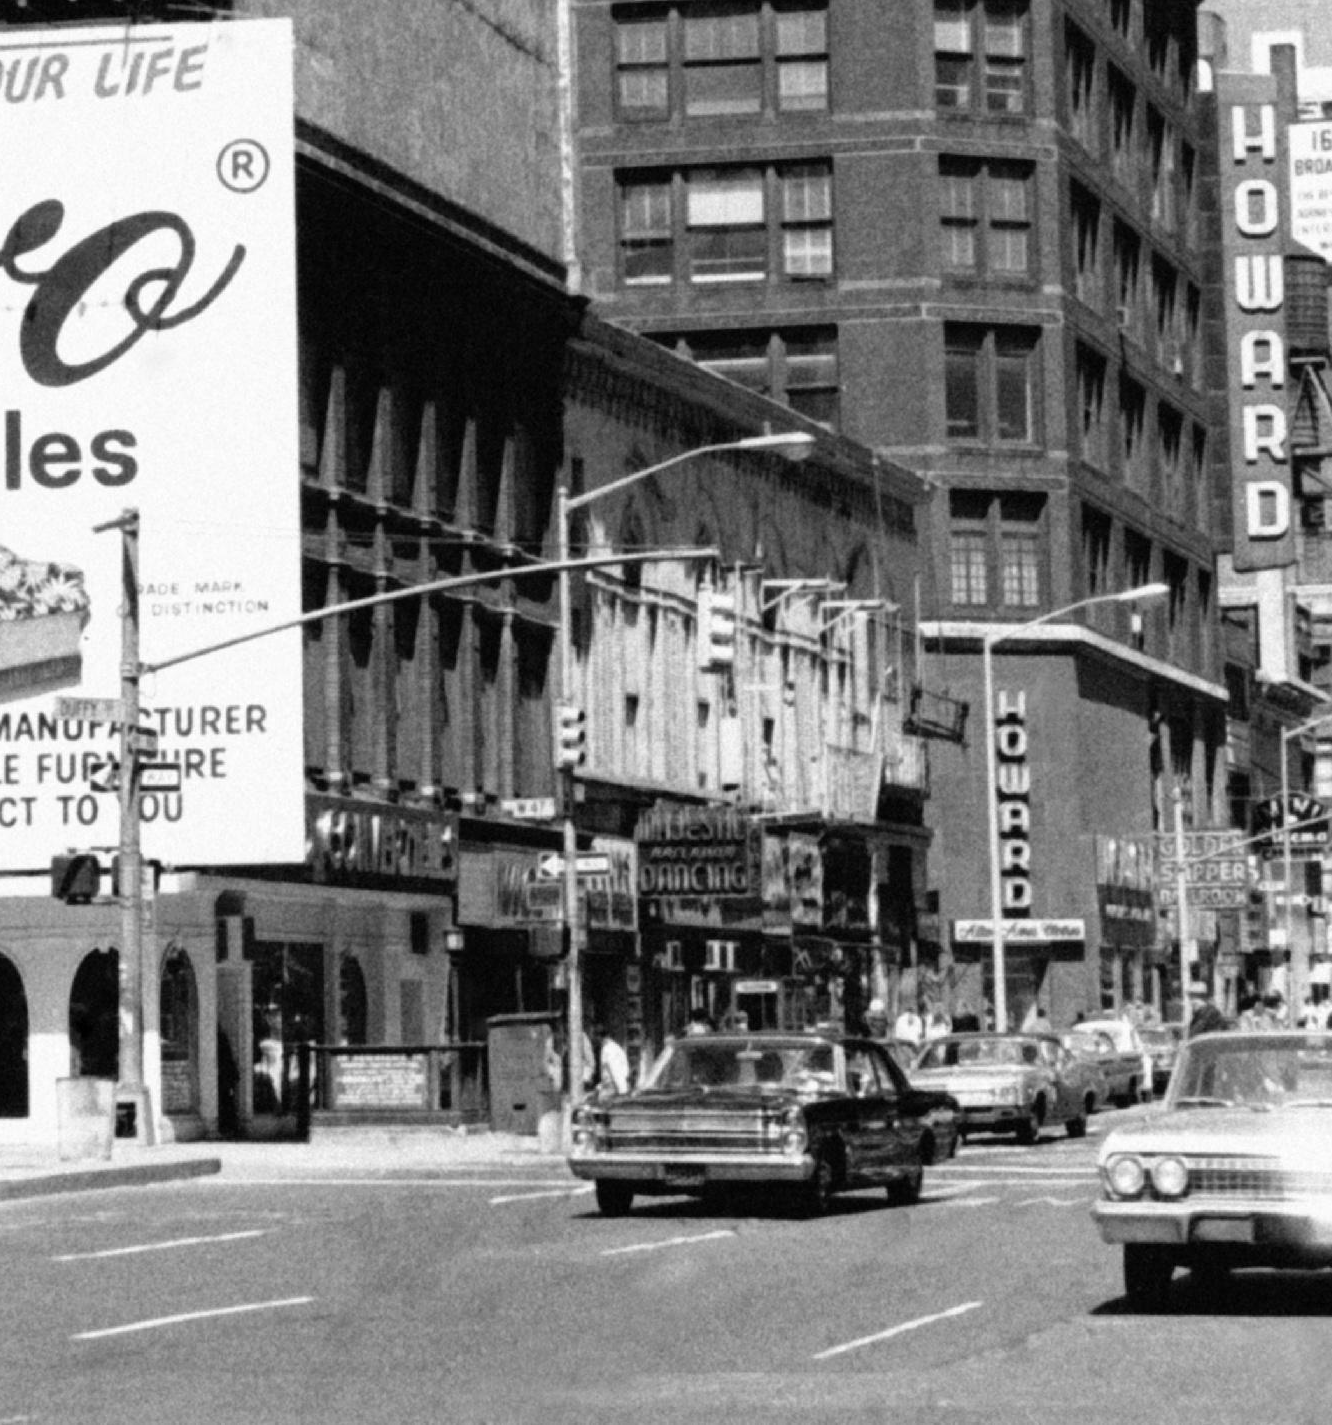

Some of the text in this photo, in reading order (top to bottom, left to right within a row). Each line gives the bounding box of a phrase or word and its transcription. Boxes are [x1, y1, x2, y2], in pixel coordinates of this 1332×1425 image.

[94, 43, 208, 97] LIFE
[1231, 104, 1289, 539] HOWARD
[151, 599, 269, 618] DISTINCTION
[58, 794, 100, 825] TO
[137, 792, 184, 824] OU
[996, 689, 1032, 913] HOWARD
[1159, 835, 1246, 855] GOLDEN
